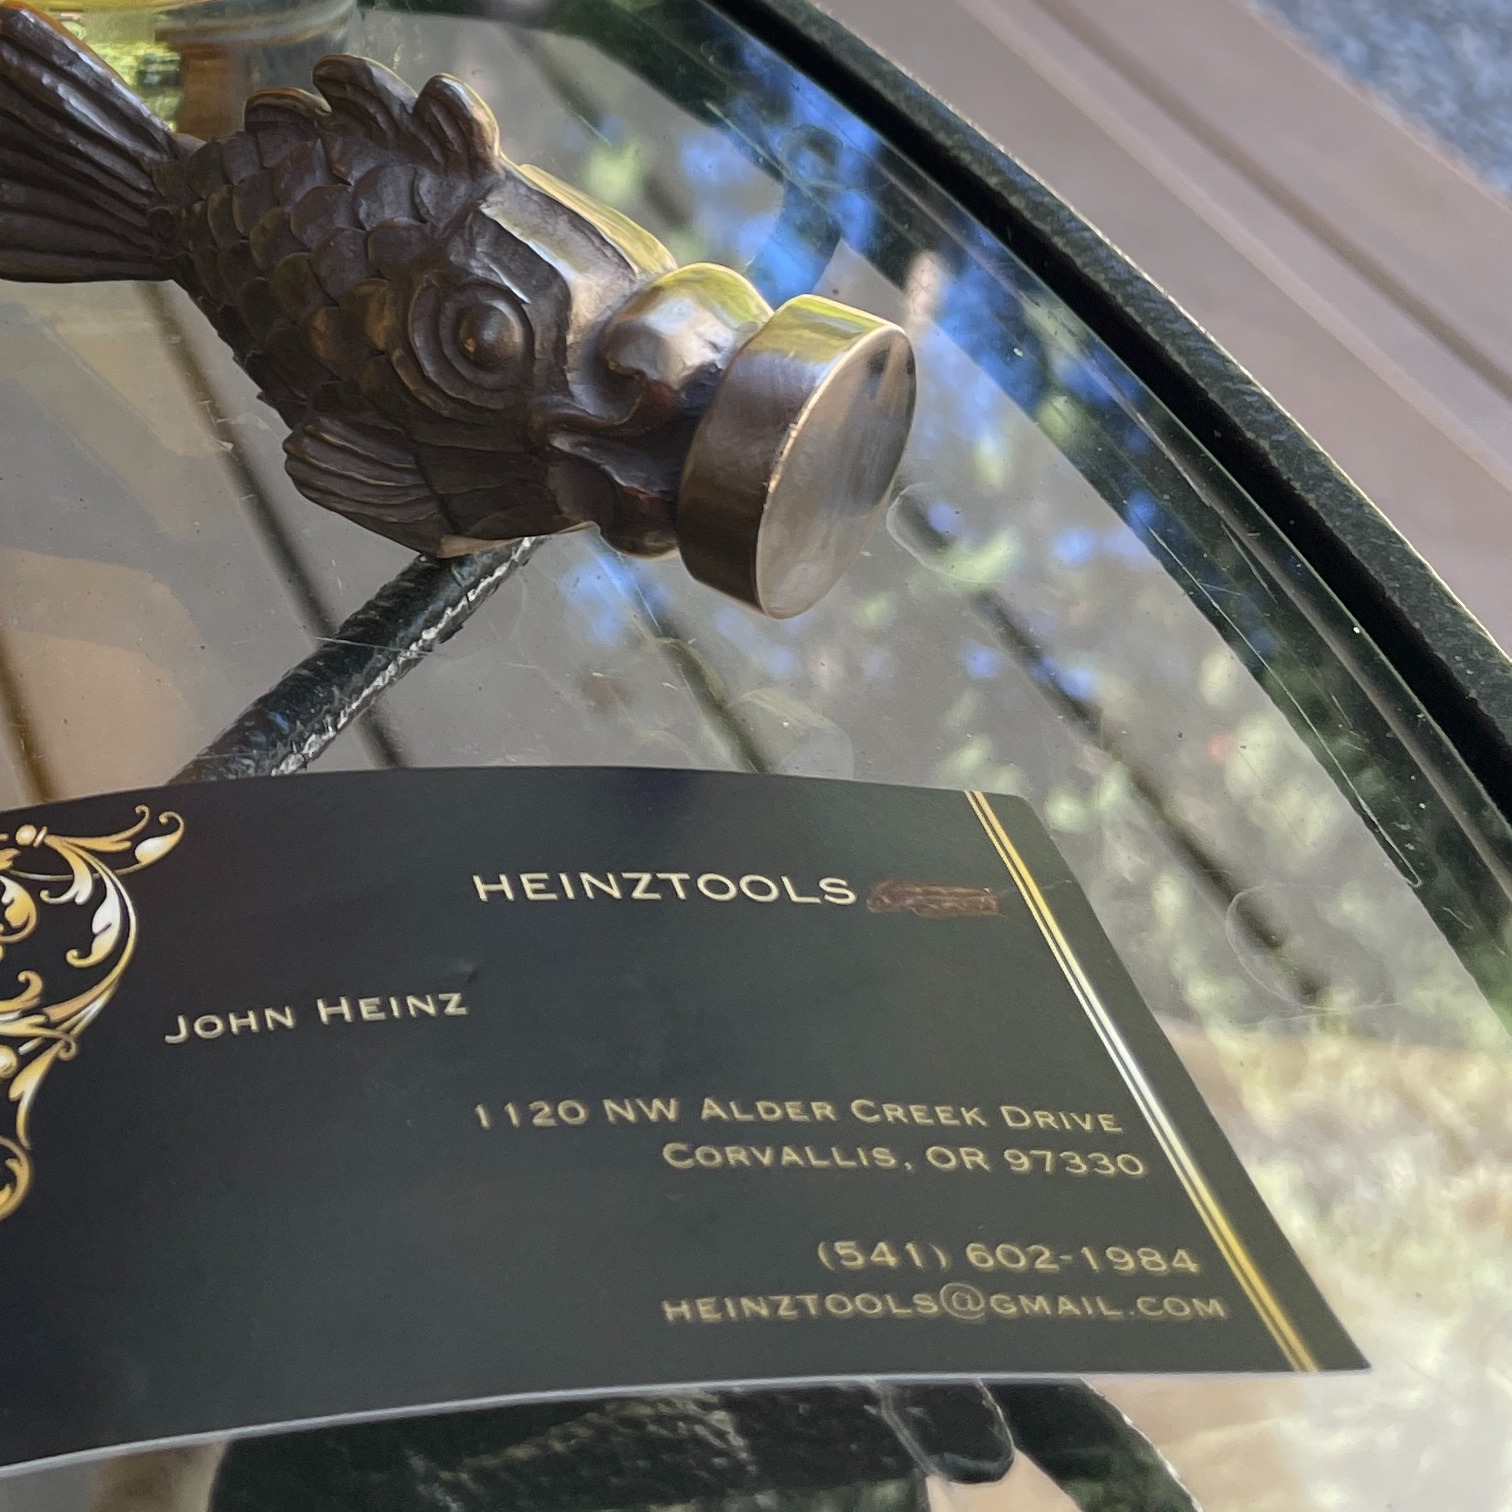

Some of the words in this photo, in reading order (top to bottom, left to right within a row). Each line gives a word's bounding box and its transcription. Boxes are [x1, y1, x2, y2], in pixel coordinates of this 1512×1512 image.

[473, 872, 858, 906] HEINZTOOLS
[164, 1006, 295, 1045] JOHN
[316, 991, 469, 1025] HEINZ
[474, 1098, 588, 1130] 1120
[603, 1098, 679, 1123] NW
[700, 1096, 836, 1123] ALDER
[850, 1098, 987, 1128] CREEK
[1000, 1105, 1124, 1135] DRIVE
[662, 1142, 915, 1172] CORVALLIS,
[925, 1147, 990, 1172] OR
[1003, 1148, 1146, 1179] 97330
[817, 1240, 949, 1271] (541)
[965, 1242, 1201, 1275] 602-1984
[662, 1282, 1228, 1324] HEINZTOOLS@GMAIL.COM
